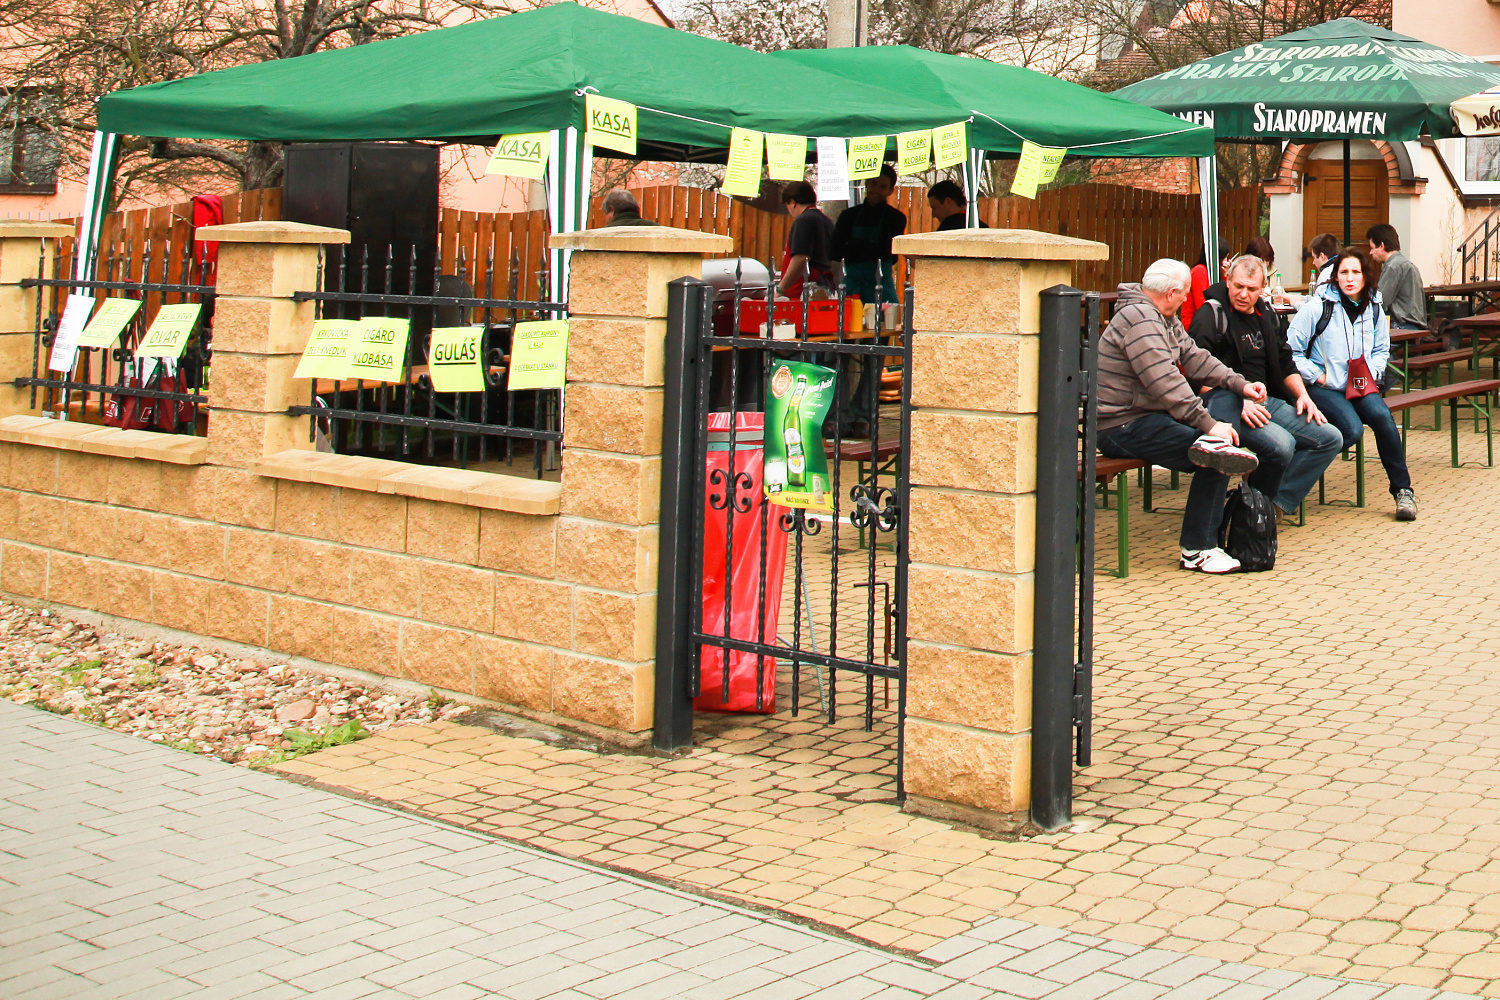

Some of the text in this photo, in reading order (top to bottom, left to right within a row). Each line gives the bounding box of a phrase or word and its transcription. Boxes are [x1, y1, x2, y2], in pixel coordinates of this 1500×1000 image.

[593, 109, 632, 134] KASA
[1253, 102, 1387, 136] STAROPRAMEN
[498, 140, 542, 159] KASA
[906, 138, 927, 149] CIGÁRO
[855, 157, 878, 171] OVAR
[150, 331, 181, 344] OVAR
[363, 327, 395, 342] CIGÁRO
[434, 337, 477, 361] GULÁŠ
[353, 351, 394, 366] KLOBÁSA
